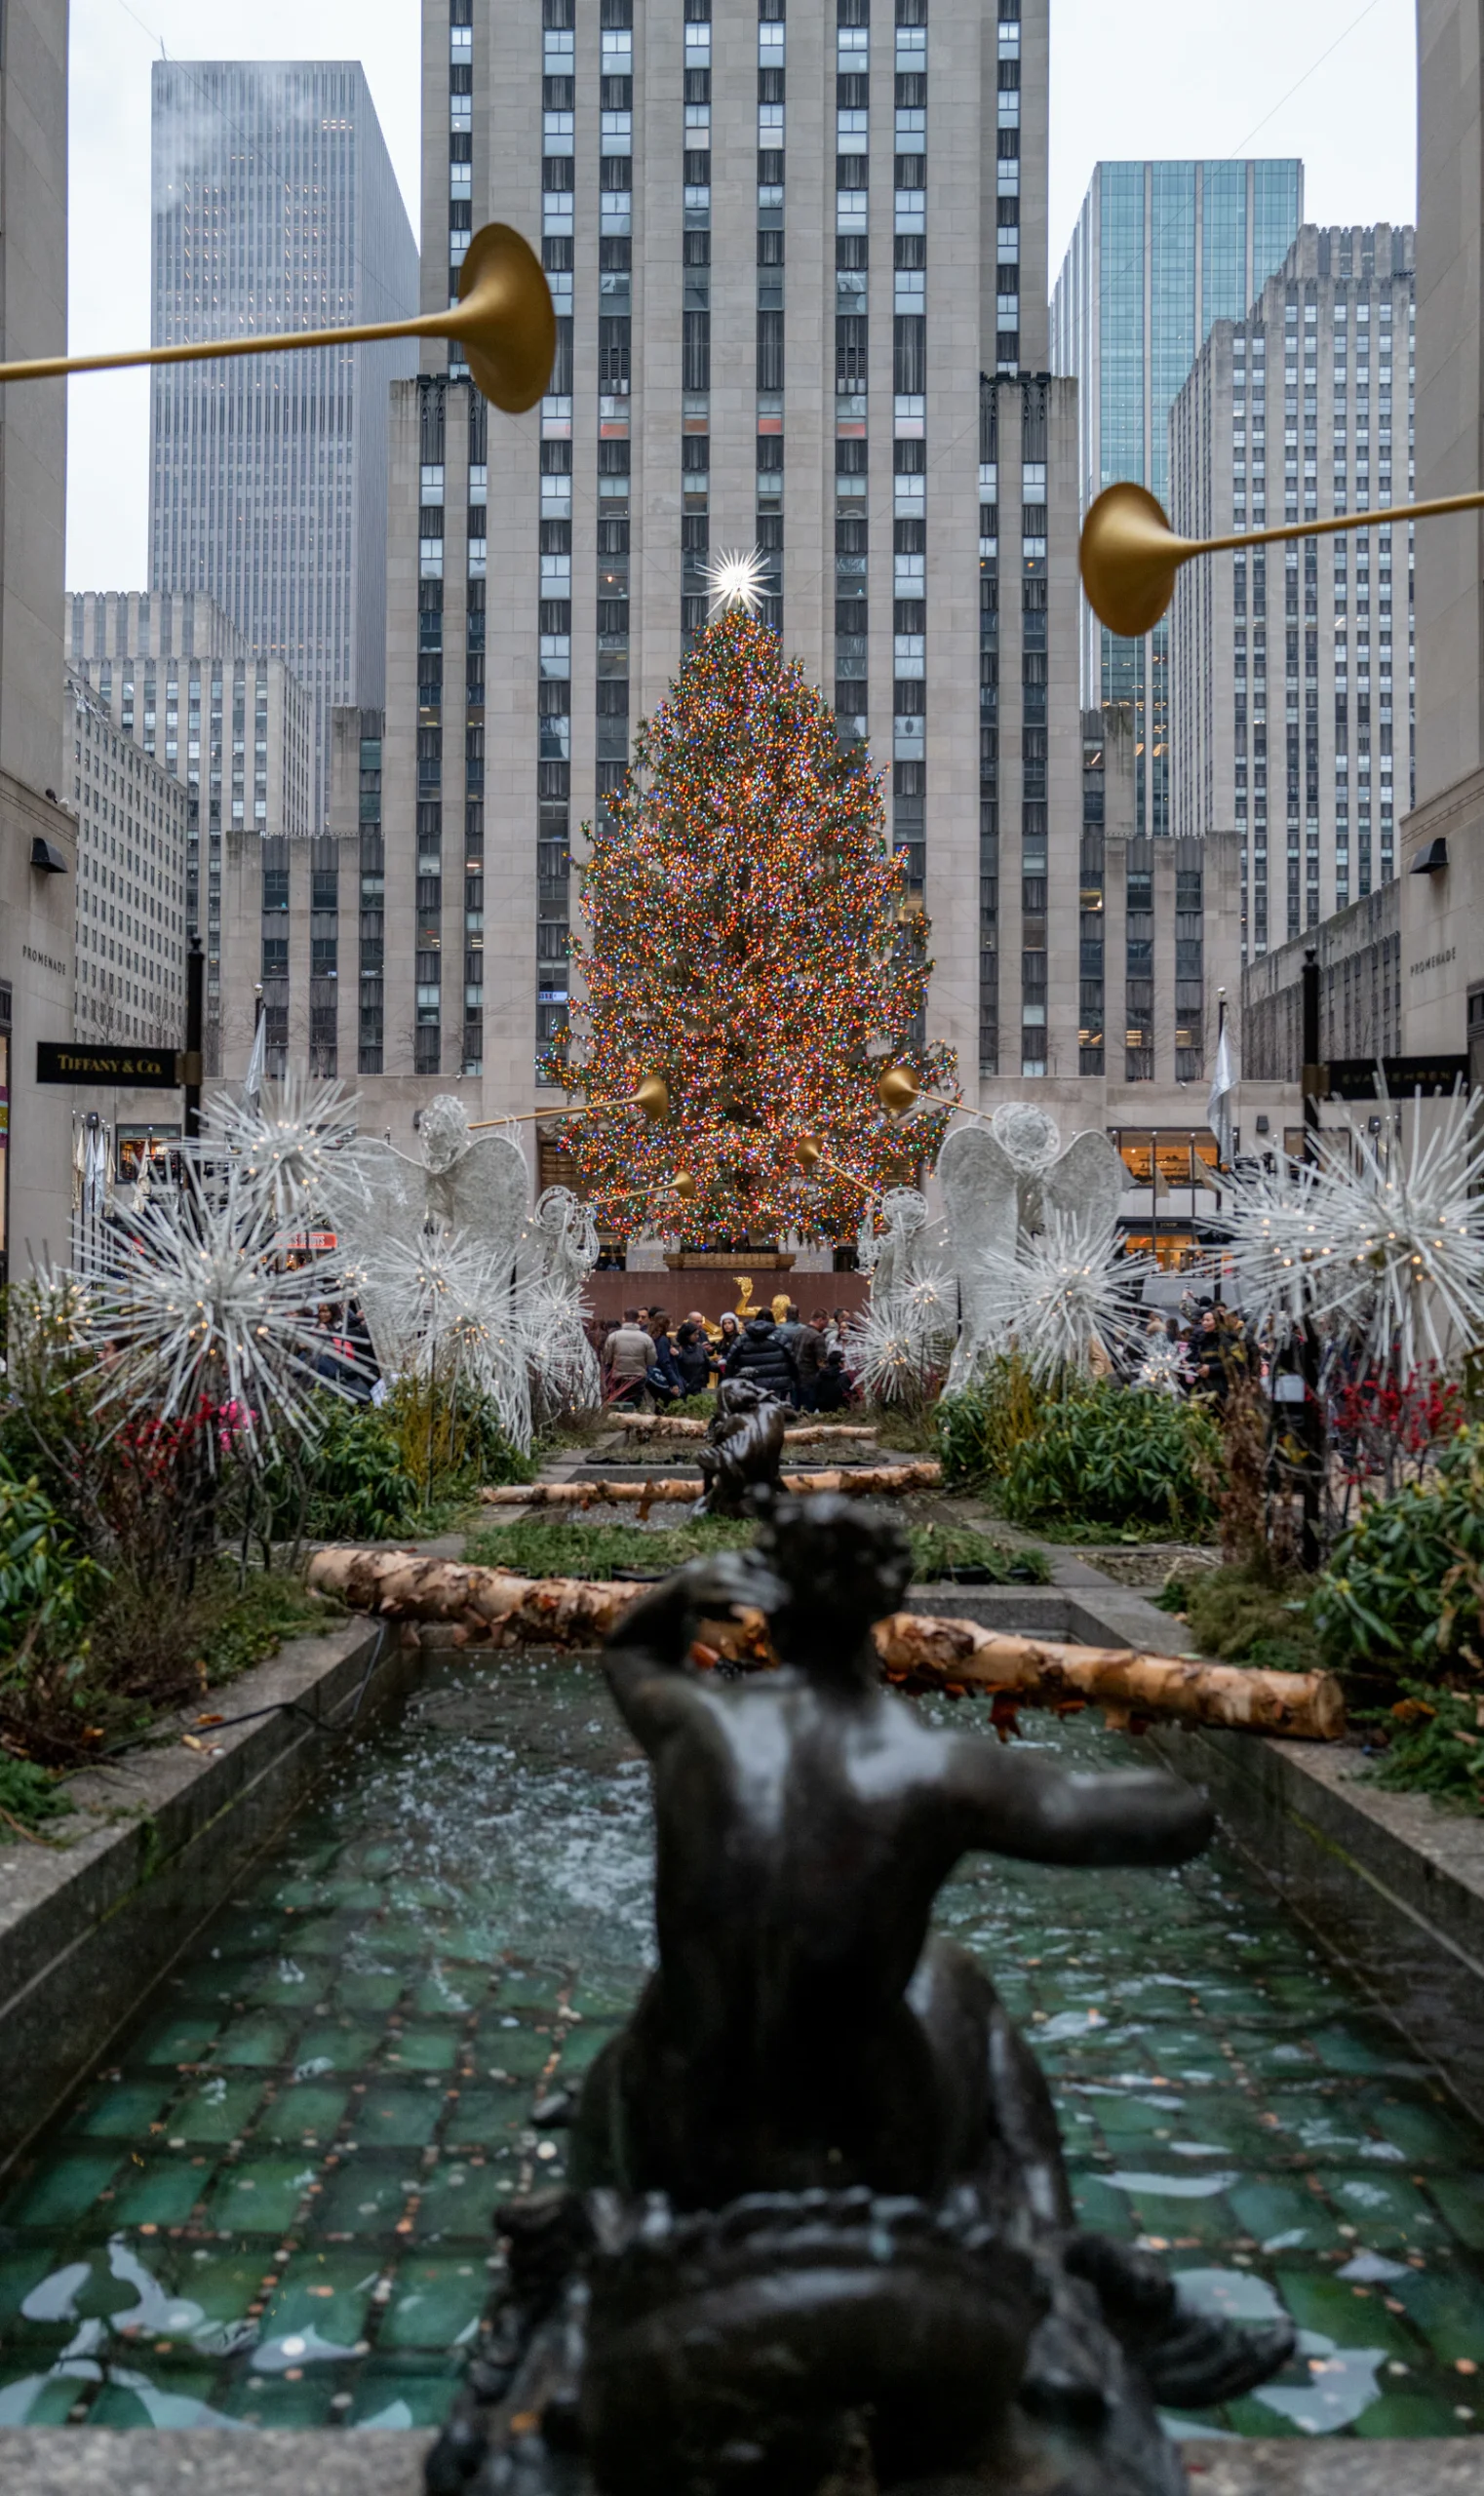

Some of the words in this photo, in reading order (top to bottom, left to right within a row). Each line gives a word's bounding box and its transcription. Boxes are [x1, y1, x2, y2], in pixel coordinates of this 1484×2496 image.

[22, 944, 66, 976] PROMENADE
[1410, 946, 1456, 977] PROMENADE
[57, 1054, 120, 1072] TIFFANY
[122, 1060, 135, 1073] &
[1383, 1071, 1451, 1083] EHREN
